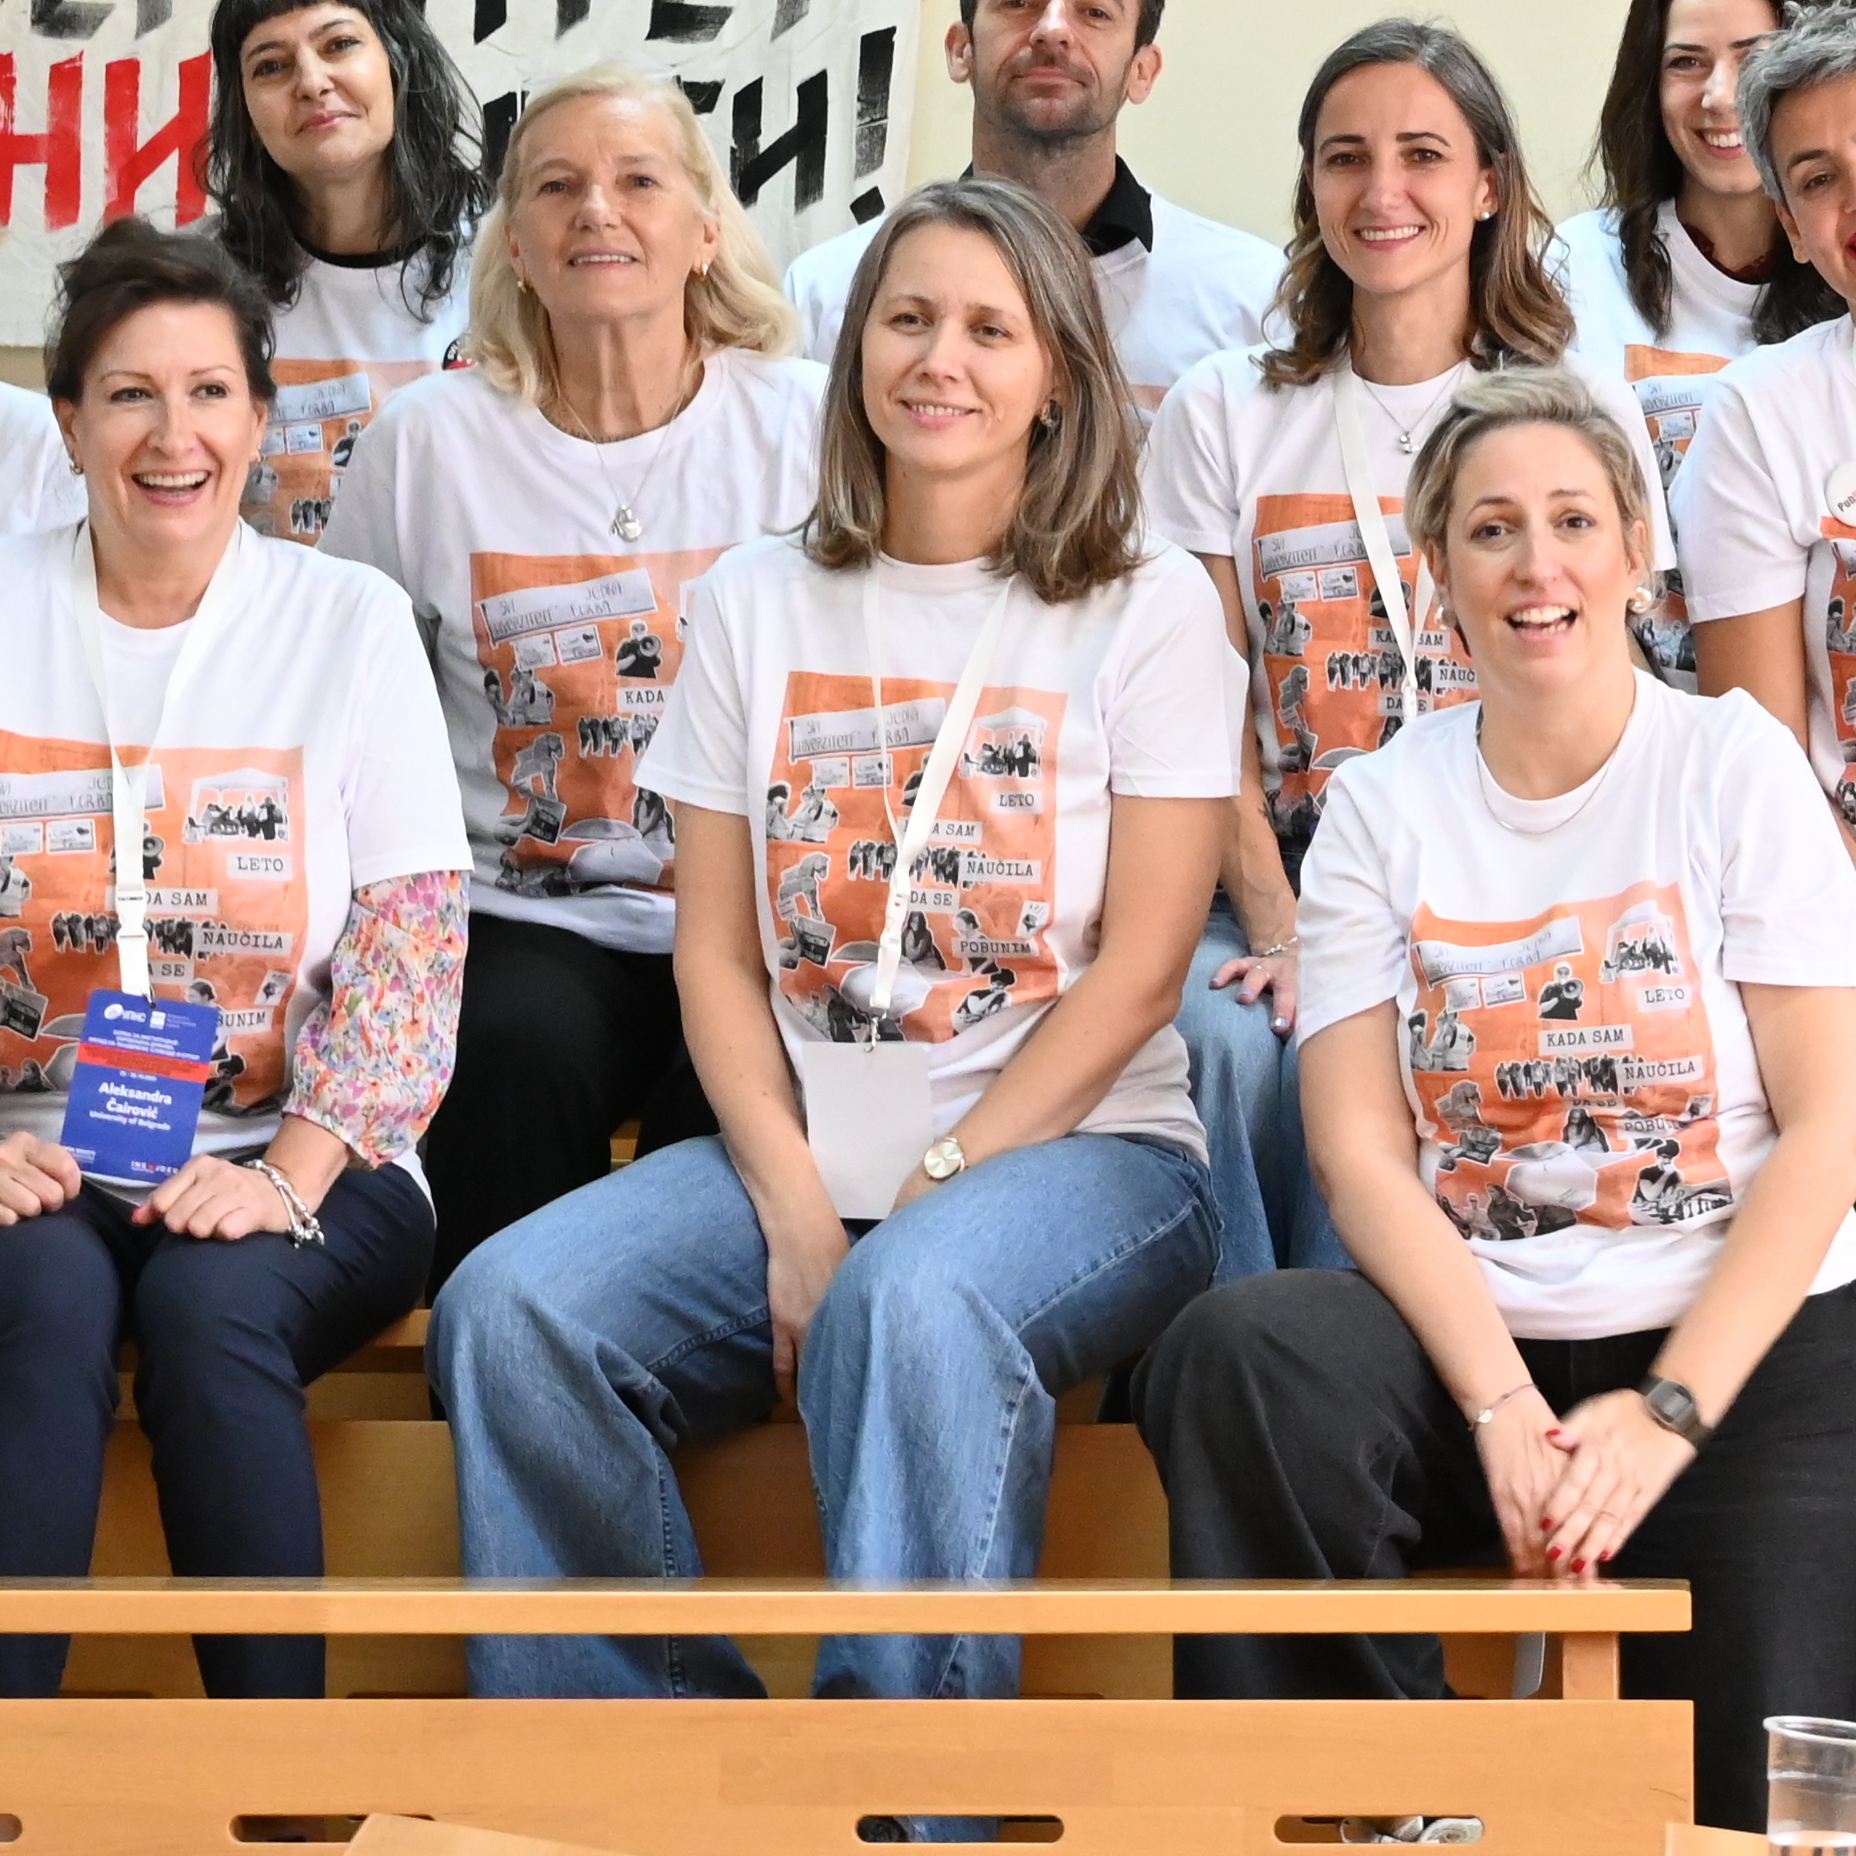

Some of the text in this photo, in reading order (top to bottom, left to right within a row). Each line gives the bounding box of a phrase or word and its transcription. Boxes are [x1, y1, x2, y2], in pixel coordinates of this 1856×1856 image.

[625, 689, 665, 704] KADA
[998, 793, 1035, 808] LETO
[945, 823, 975, 837] SAM
[237, 856, 284, 872] LETO
[966, 860, 1034, 877] NAUČILA
[170, 892, 208, 906] SAM
[910, 890, 953, 906] DA SE
[203, 928, 284, 949] NAUČILA
[960, 940, 1031, 954] POBUNIM
[161, 964, 185, 977] SE
[1645, 988, 1685, 1004] LETO
[217, 1011, 266, 1027] BUNIM
[1546, 1028, 1624, 1047] KADA SAM
[1625, 1060, 1696, 1080] NAUČILA
[98, 1082, 172, 1105] Aleksandra
